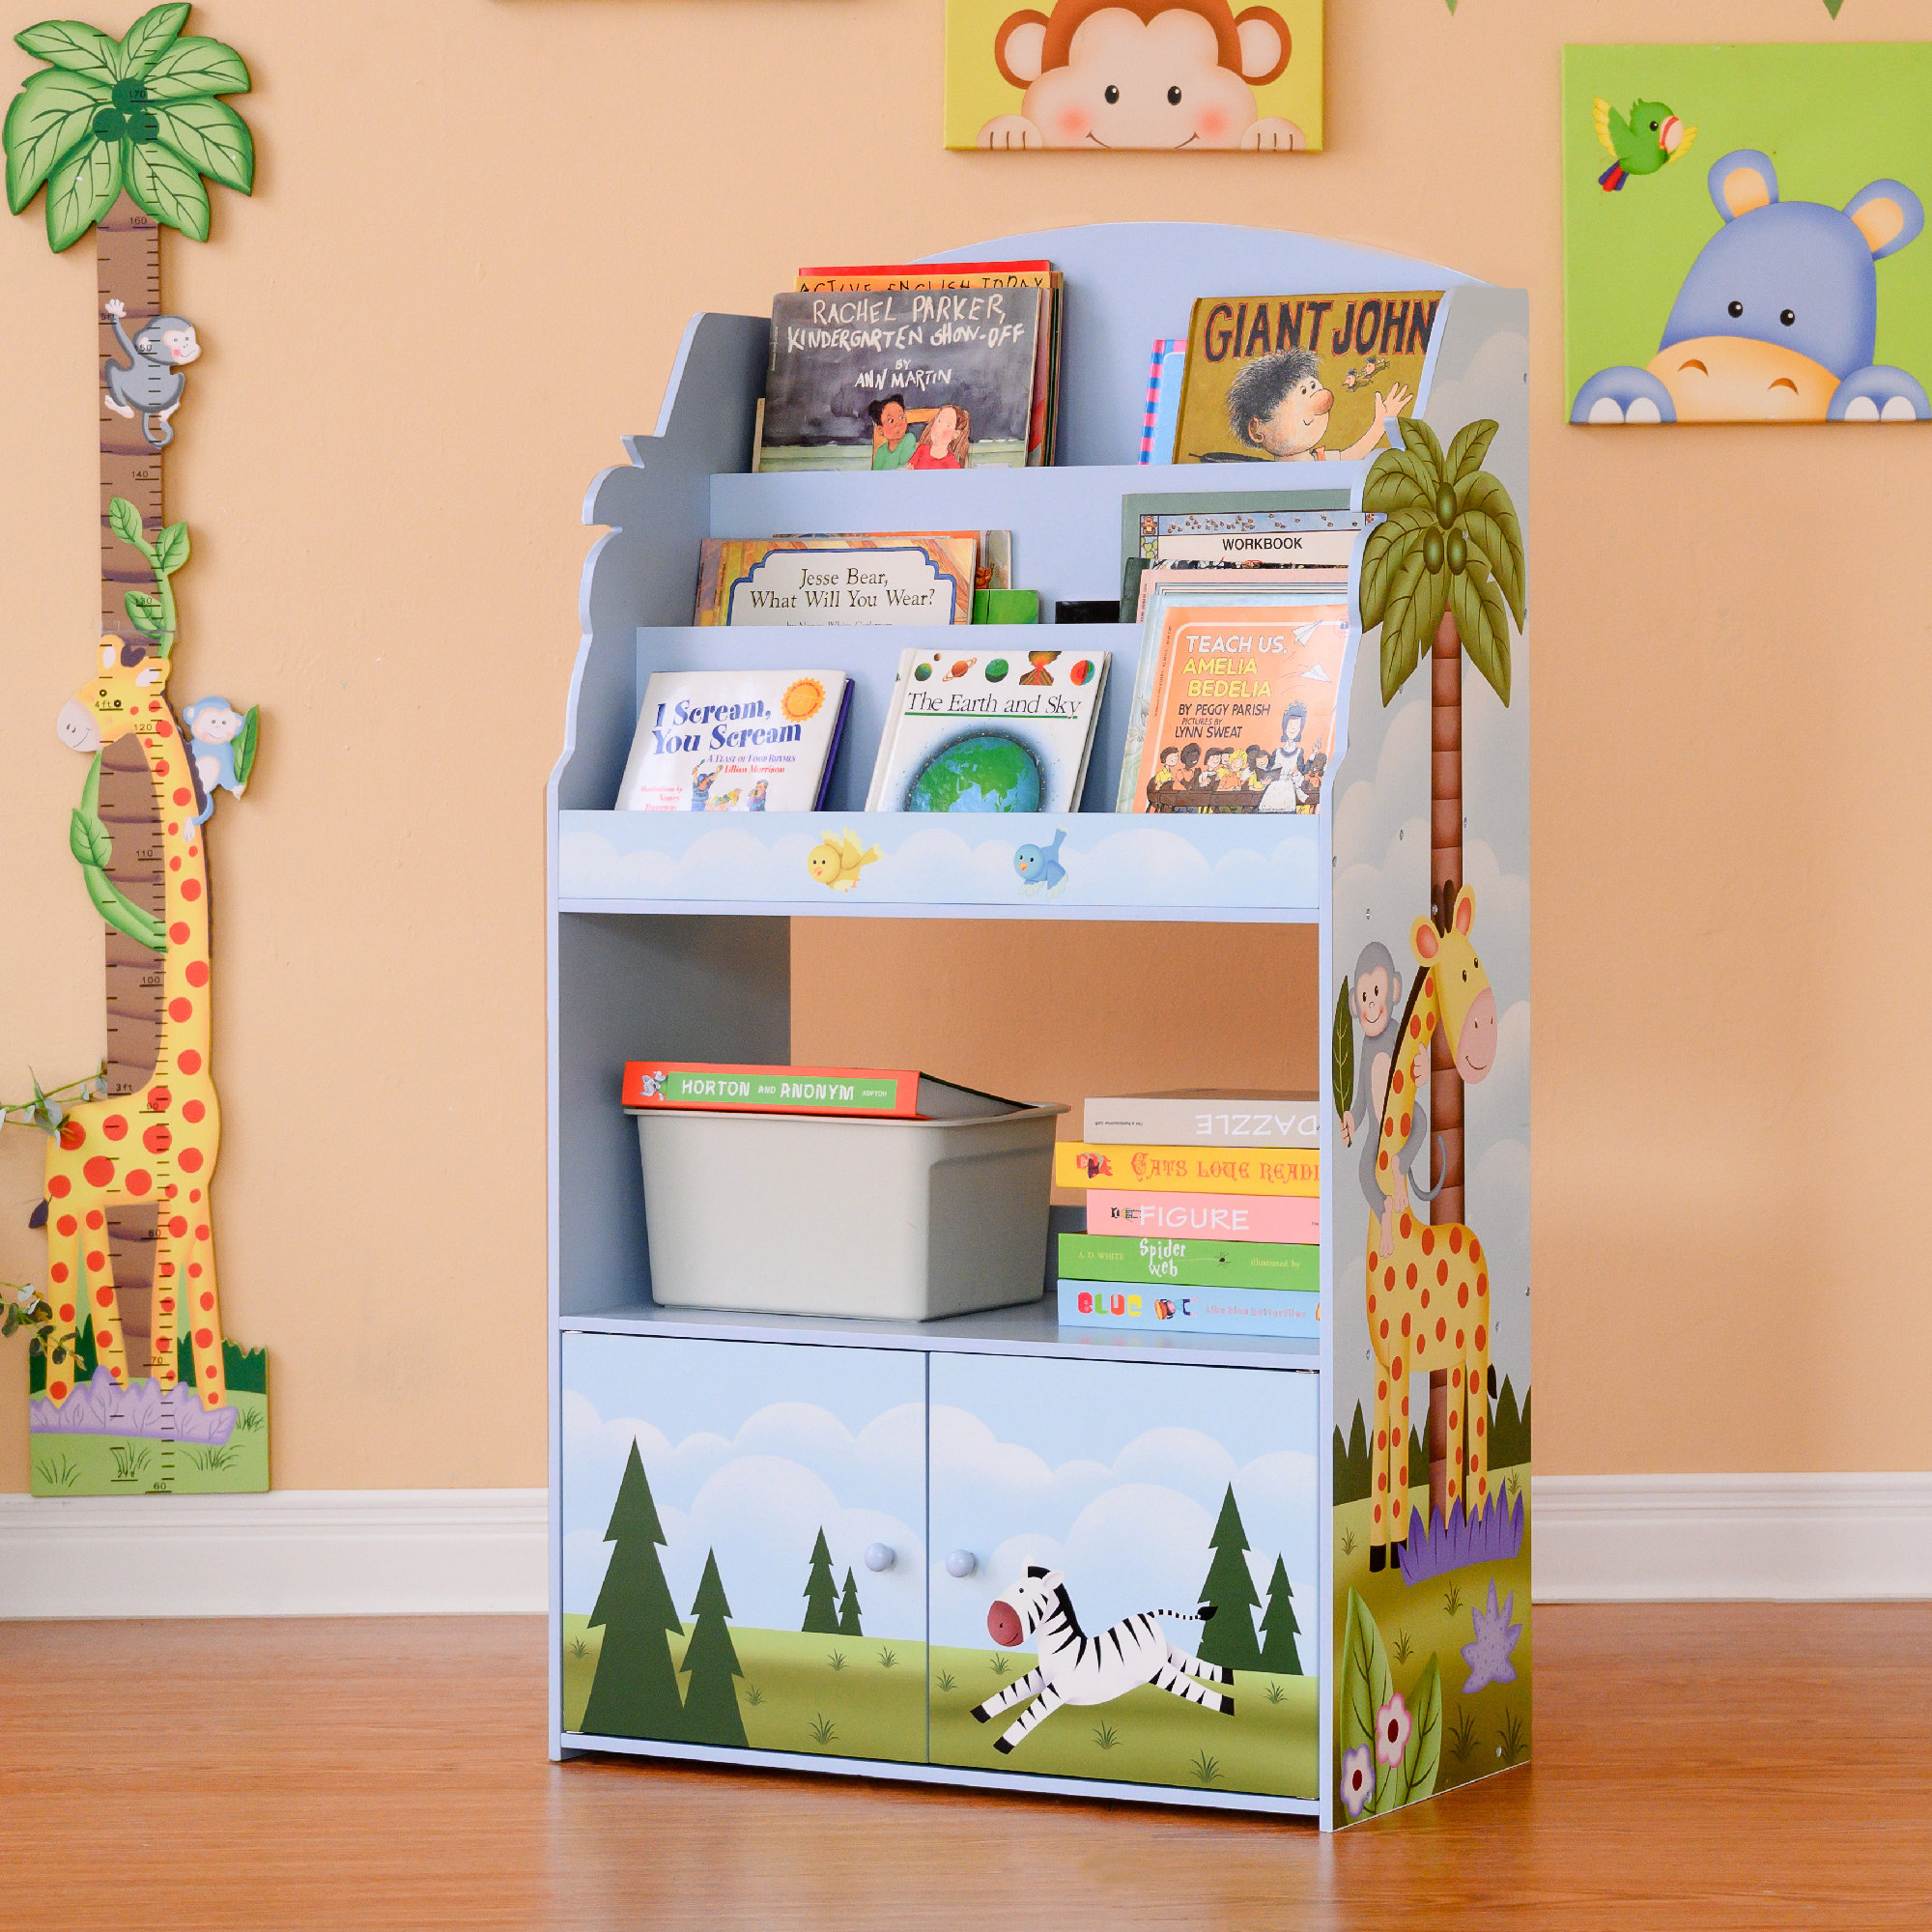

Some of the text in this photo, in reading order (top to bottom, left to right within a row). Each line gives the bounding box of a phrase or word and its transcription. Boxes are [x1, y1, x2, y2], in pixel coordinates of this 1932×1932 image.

[129, 216, 148, 225] 160
[812, 294, 1007, 327] RACHEL PARKER,
[787, 326, 923, 354] KINDERGARTEN
[929, 324, 1026, 349] SHOW-OFF
[1203, 298, 1440, 363] GIANT JOHN
[895, 358, 912, 371] BY
[854, 368, 952, 391] ANN MARTIN
[1221, 537, 1304, 552] WORKBOOK
[799, 567, 890, 590] Jesse Bear,
[750, 587, 936, 610] What Will You Wear?
[1185, 634, 1289, 656] TEACH US,
[1181, 657, 1259, 676] AMELIA
[1187, 679, 1273, 699] BEDELIA
[655, 702, 667, 727] I
[672, 698, 773, 726] Scream,
[908, 692, 1082, 720] The Earth and Sky
[1178, 703, 1271, 717] BY PEGGY PARISH
[1175, 725, 1244, 739] LYNN SWEAT
[1181, 718, 1224, 726] PICTURES BY
[651, 724, 802, 755] You Scream
[141, 976, 160, 984] 100
[681, 1078, 751, 1097] HORTON
[757, 1084, 776, 1094] AND
[780, 1082, 855, 1100] ANONYM
[1195, 1114, 1319, 1136] DAZZLE
[1140, 1205, 1250, 1231] FIGURE
[1139, 1237, 1187, 1267] Spider
[1149, 1259, 1179, 1277] web
[151, 1356, 163, 1365] 70
